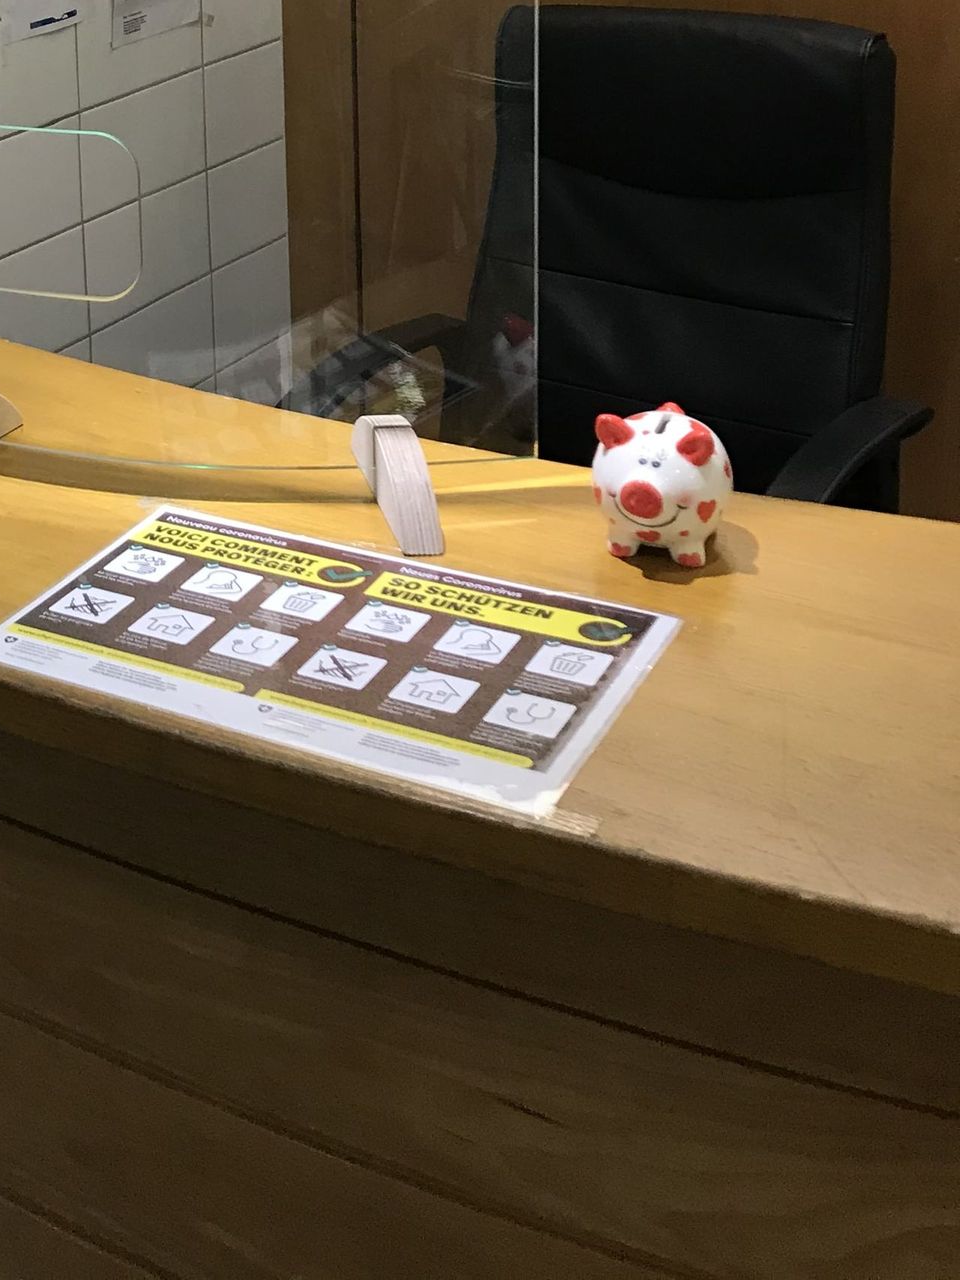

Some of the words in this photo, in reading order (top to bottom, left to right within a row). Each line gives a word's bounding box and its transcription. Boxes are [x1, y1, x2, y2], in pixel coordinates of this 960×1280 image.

[143, 532, 199, 551] NOUS
[155, 525, 208, 543] VOICI
[210, 538, 319, 567] COMMENT
[166, 515, 217, 532] Nouveau
[219, 528, 287, 547] coronavirus
[388, 577, 421, 590] SO
[425, 585, 554, 619] SCHÜTZEN
[399, 567, 440, 581] Neues
[442, 575, 522, 598] Coronavirus
[381, 587, 426, 604] WIR
[430, 598, 485, 617] UNS.
